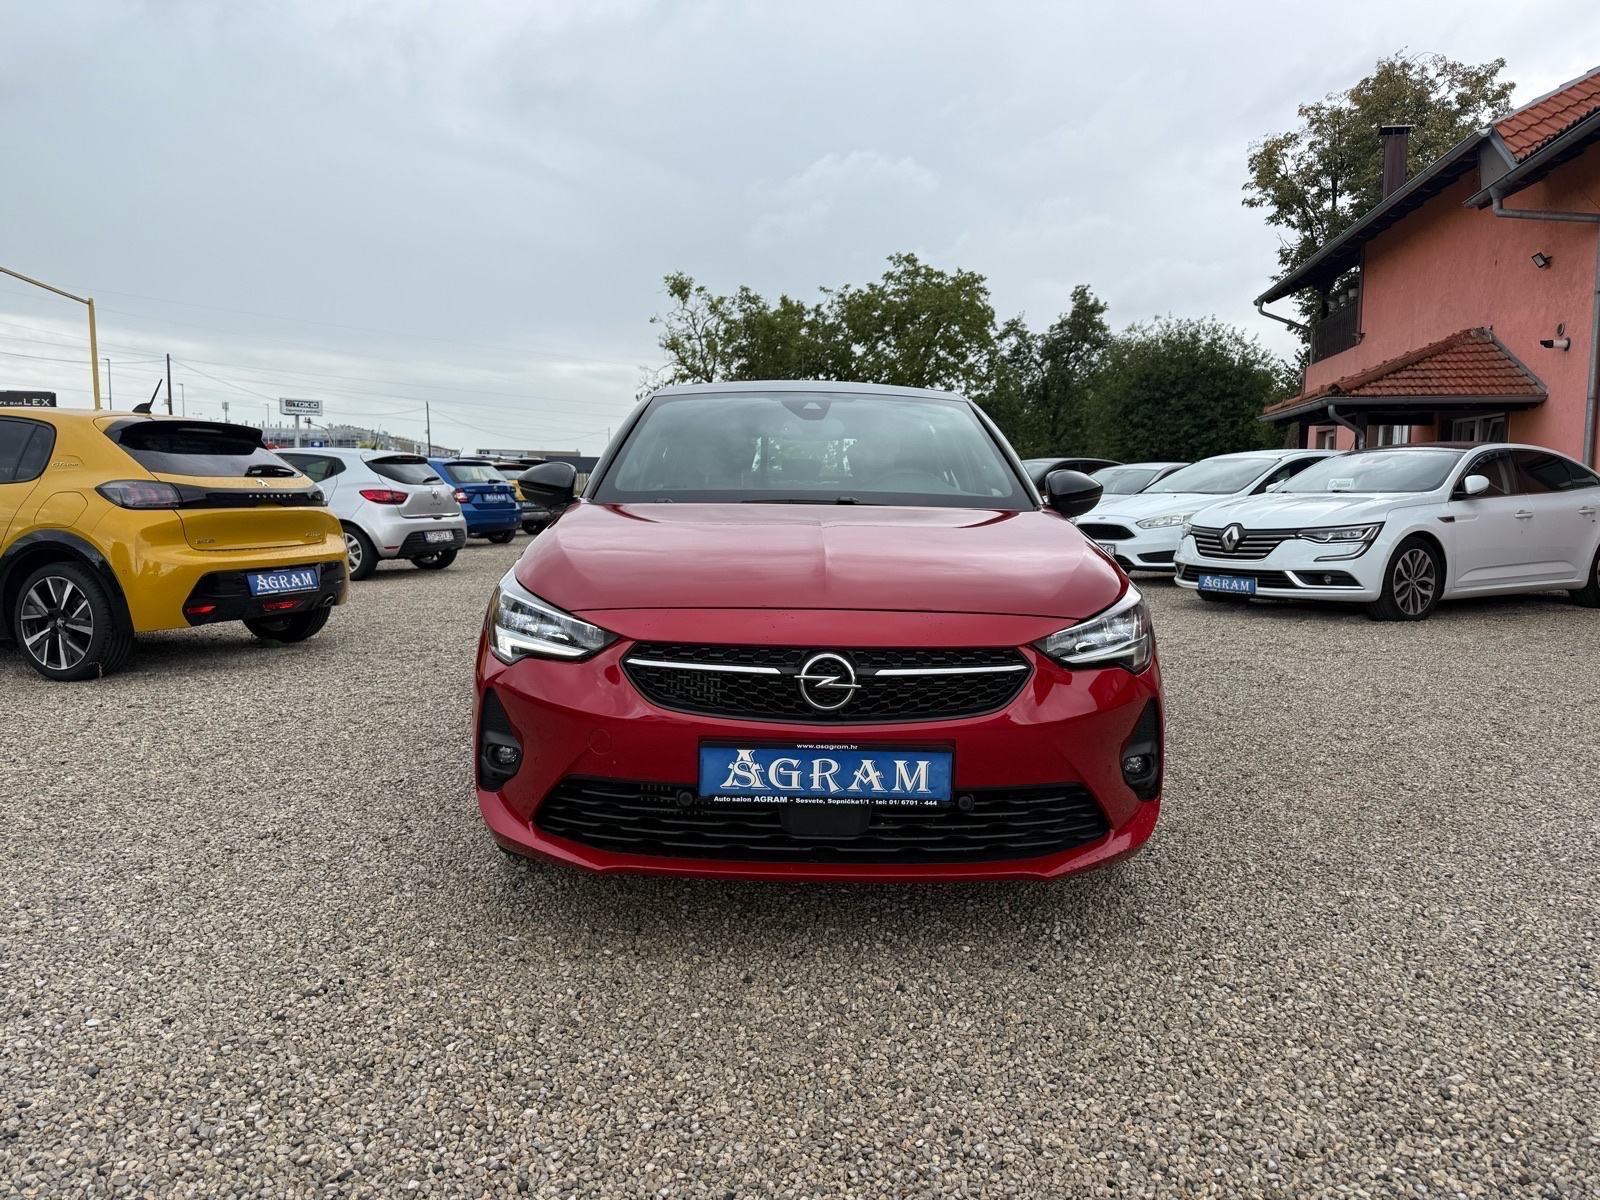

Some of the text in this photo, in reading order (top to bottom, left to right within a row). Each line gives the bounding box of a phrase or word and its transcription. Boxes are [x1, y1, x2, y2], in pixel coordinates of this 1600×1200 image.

[23, 398, 51, 407] LEX
[256, 572, 314, 591] AGRAM
[1202, 575, 1250, 592] AGRAM
[796, 743, 858, 751] www.asagram.hr
[720, 749, 933, 795] AGRAM
[753, 796, 788, 804] AGRAM
[795, 797, 826, 805] Sesvete,
